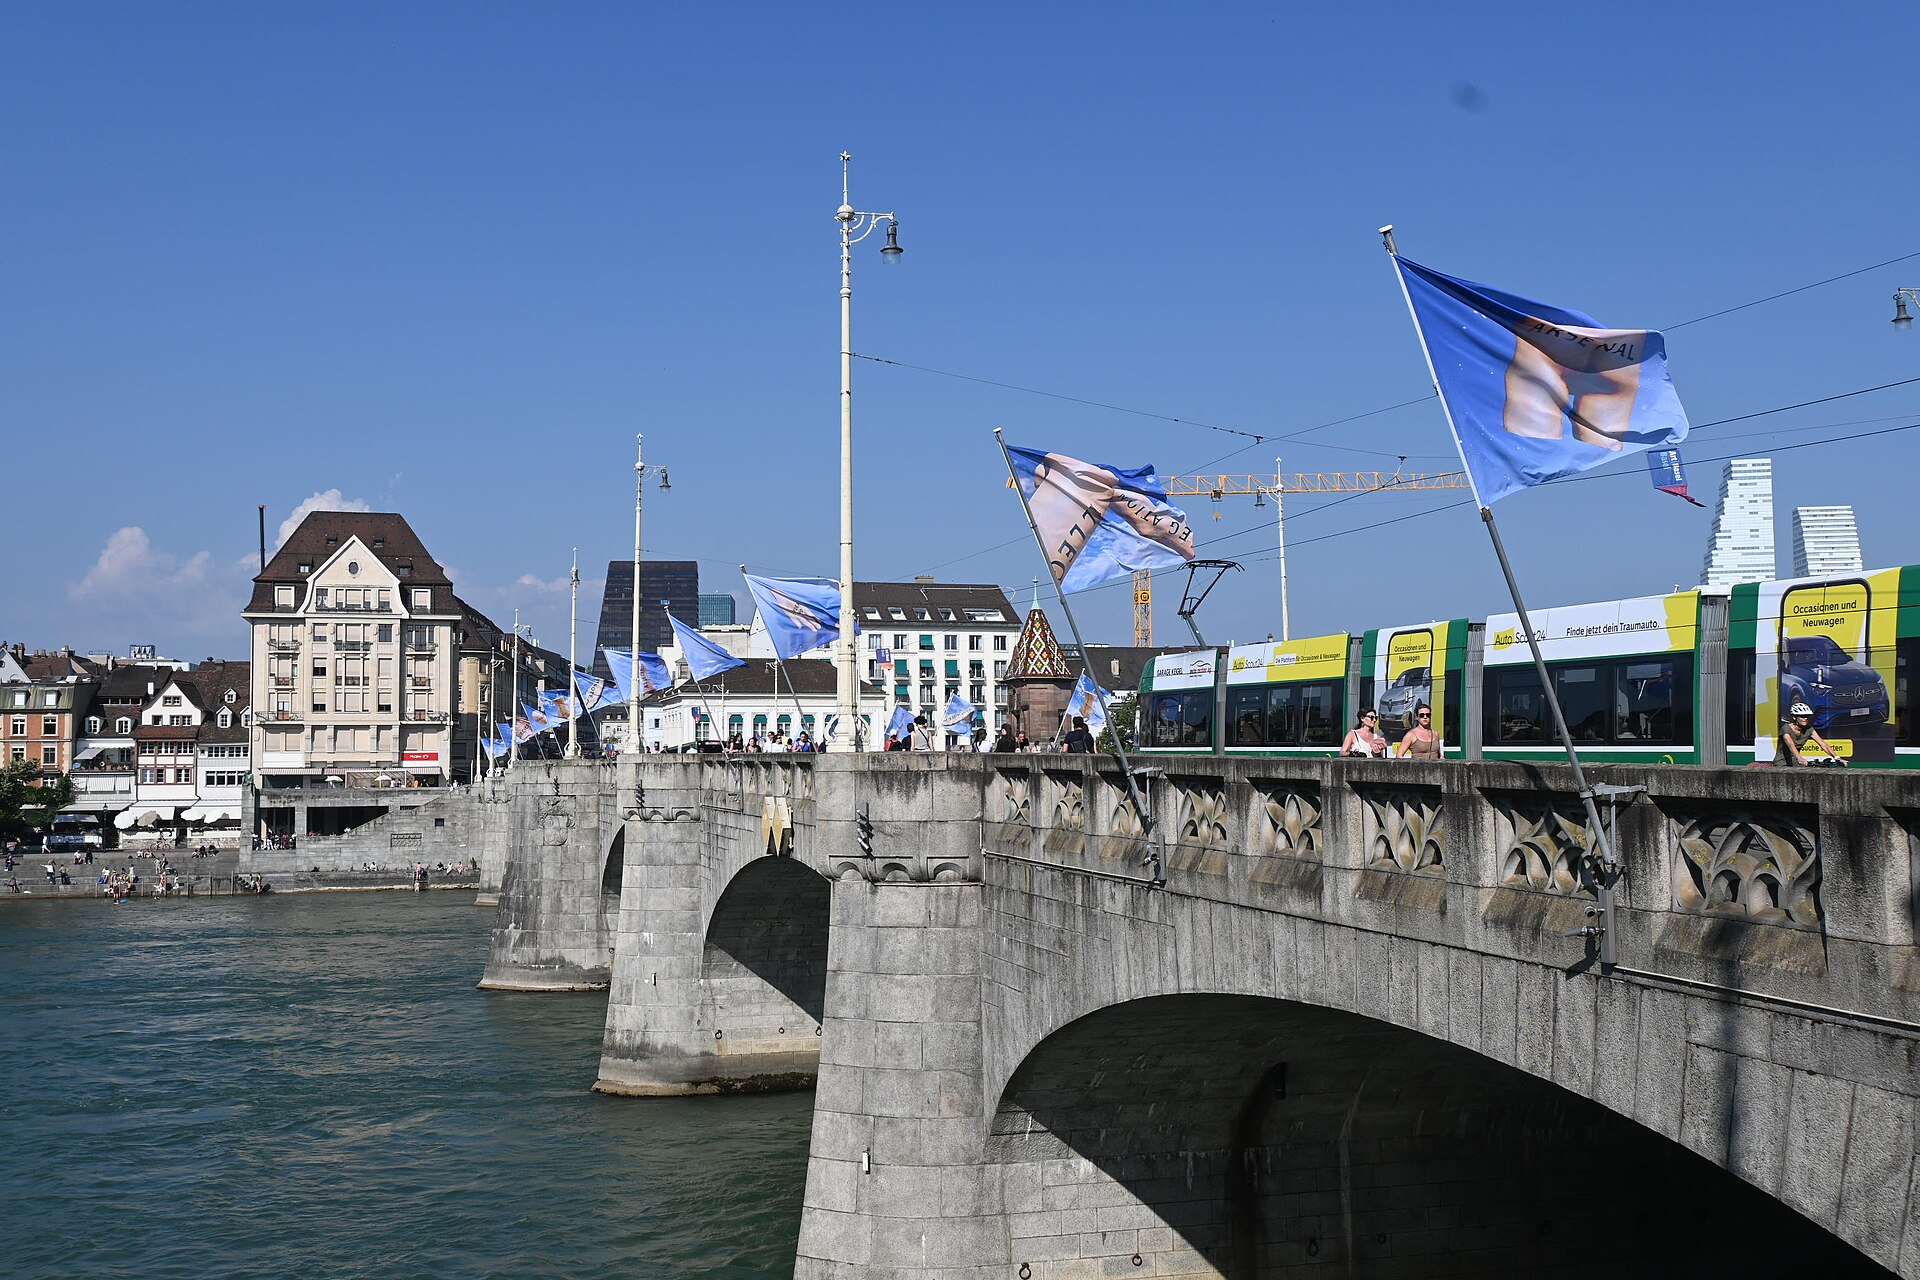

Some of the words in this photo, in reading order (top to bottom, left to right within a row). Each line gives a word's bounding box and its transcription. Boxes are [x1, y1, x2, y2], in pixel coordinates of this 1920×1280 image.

[1793, 602, 1839, 614] Occasionen
[1841, 600, 1857, 610] und
[1566, 627, 1585, 637] Finde
[1585, 624, 1602, 637] jetzt
[1602, 622, 1618, 633] dein
[1619, 620, 1660, 632] Traumauto.
[1802, 617, 1845, 628] Neuwagen
[1494, 633, 1513, 646] Auto
[1515, 630, 1546, 644] Scot24
